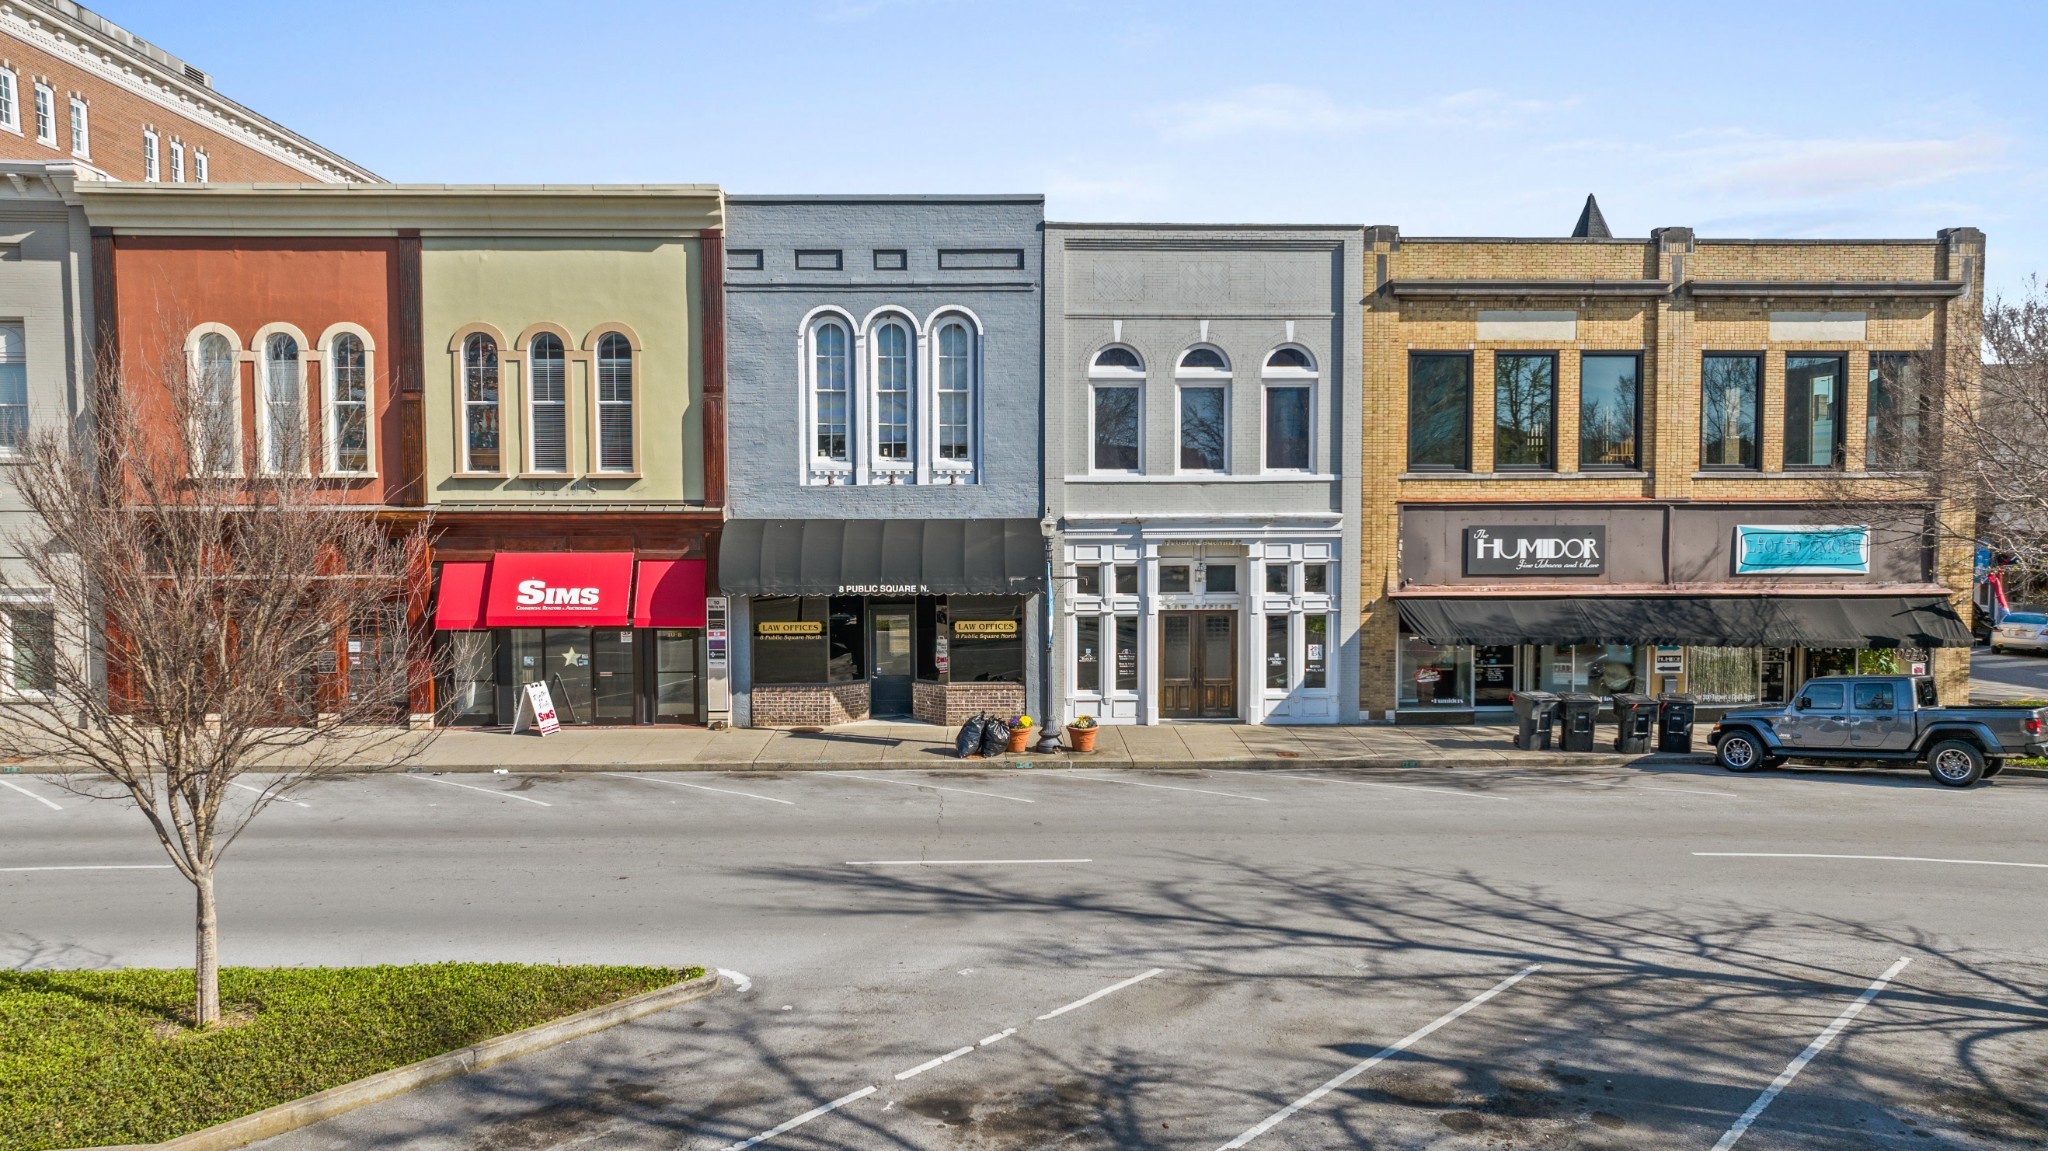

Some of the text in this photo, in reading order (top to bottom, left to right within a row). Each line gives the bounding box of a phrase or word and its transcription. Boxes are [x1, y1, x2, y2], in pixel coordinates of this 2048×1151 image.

[1474, 529, 1489, 539] The
[1476, 538, 1600, 559] HUMIDOR
[1516, 559, 1533, 570] Fine
[1534, 559, 1562, 569] Tobacco
[1579, 559, 1600, 569] More
[517, 579, 600, 605] SIMS
[838, 585, 930, 593] 8 PUBLIC SQUARE N.
[978, 623, 1015, 631] OFFICES
[538, 709, 555, 722] SIMS
